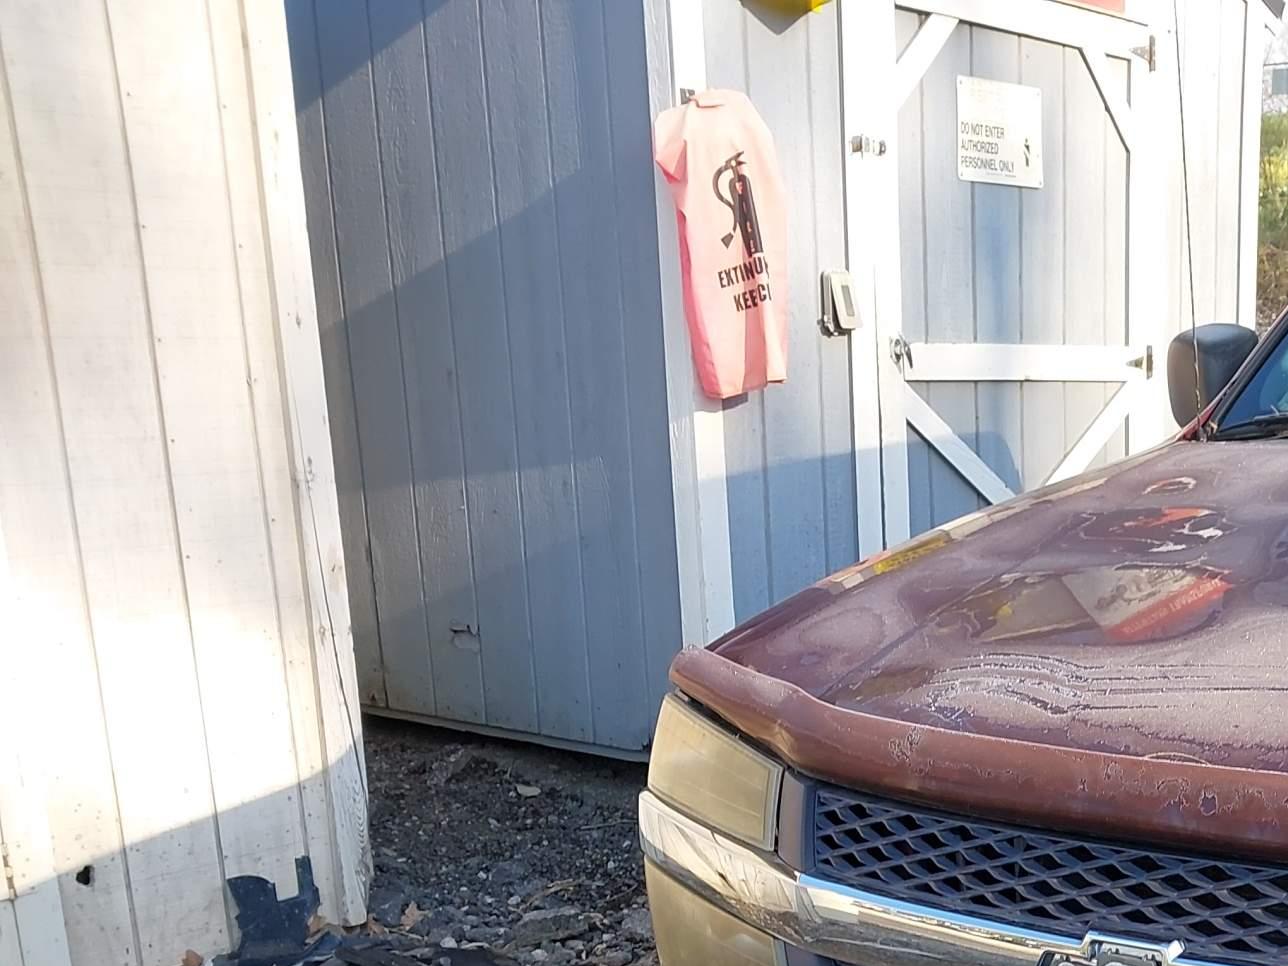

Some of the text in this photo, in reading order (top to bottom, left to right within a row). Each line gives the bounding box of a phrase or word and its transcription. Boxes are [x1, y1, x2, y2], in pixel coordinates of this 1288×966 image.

[960, 121, 1005, 139] DO NOT ENTER
[960, 139, 999, 155] AUTHORIZED
[960, 155, 1015, 173] PERSONNEL ONLY
